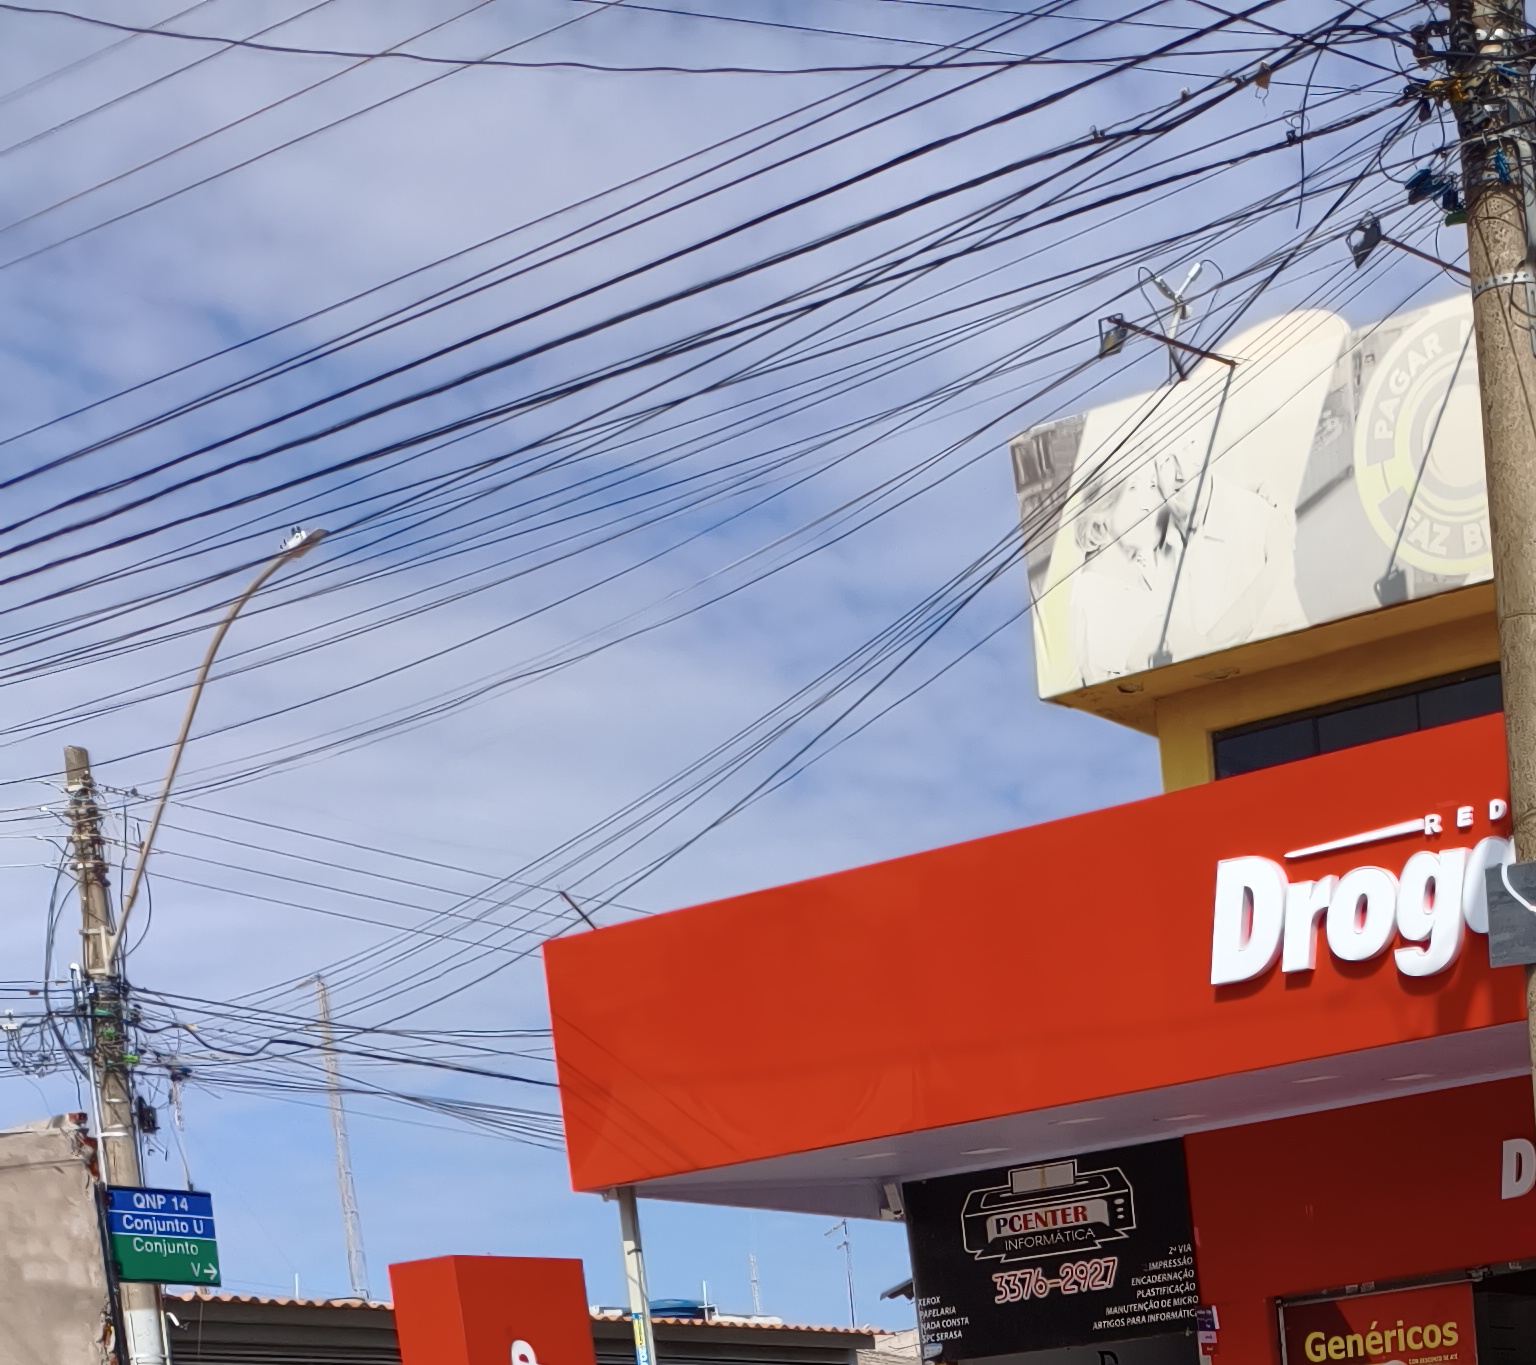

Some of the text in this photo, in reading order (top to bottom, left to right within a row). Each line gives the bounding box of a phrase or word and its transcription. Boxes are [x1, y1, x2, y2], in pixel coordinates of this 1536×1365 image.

[1374, 332, 1443, 440] PAGAR
[1424, 798, 1507, 835] RED
[133, 1192, 188, 1211] QNP 14
[122, 1214, 204, 1235] Conjunto U
[995, 1205, 1088, 1235] PCENTER
[132, 1237, 199, 1257] Conjunto
[1005, 1227, 1096, 1250] INFORMÁTICA
[190, 1261, 201, 1278] V
[1149, 1255, 1193, 1271] IMPRESSÃO
[992, 1256, 1118, 1304] 3376-2927
[1131, 1269, 1194, 1286] ENCADERNAÇÃO
[1136, 1281, 1196, 1299] PLASTIFICAÇÃO
[1106, 1295, 1199, 1316] MANUTENÇÃO DE MICRO
[941, 1316, 970, 1328] CONSTA
[1092, 1317, 1126, 1331] ARTIGOS
[1126, 1315, 1147, 1326] PARA
[1305, 1320, 1459, 1363] Genéricos
